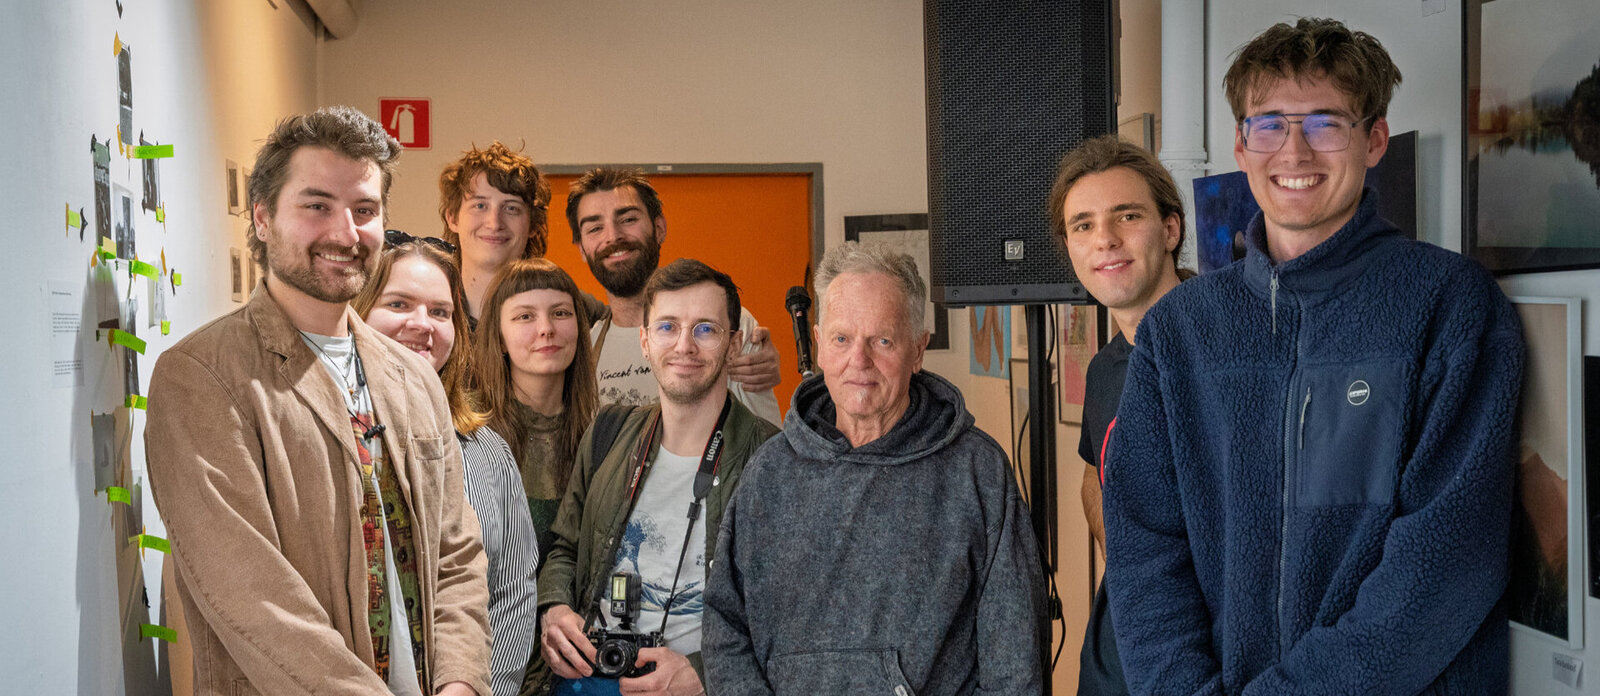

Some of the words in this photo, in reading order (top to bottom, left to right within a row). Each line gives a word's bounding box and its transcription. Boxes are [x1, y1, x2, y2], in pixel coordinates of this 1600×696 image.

[600, 364, 633, 381] Vincent
[634, 366, 651, 375] van
[706, 430, 723, 461] Canon
